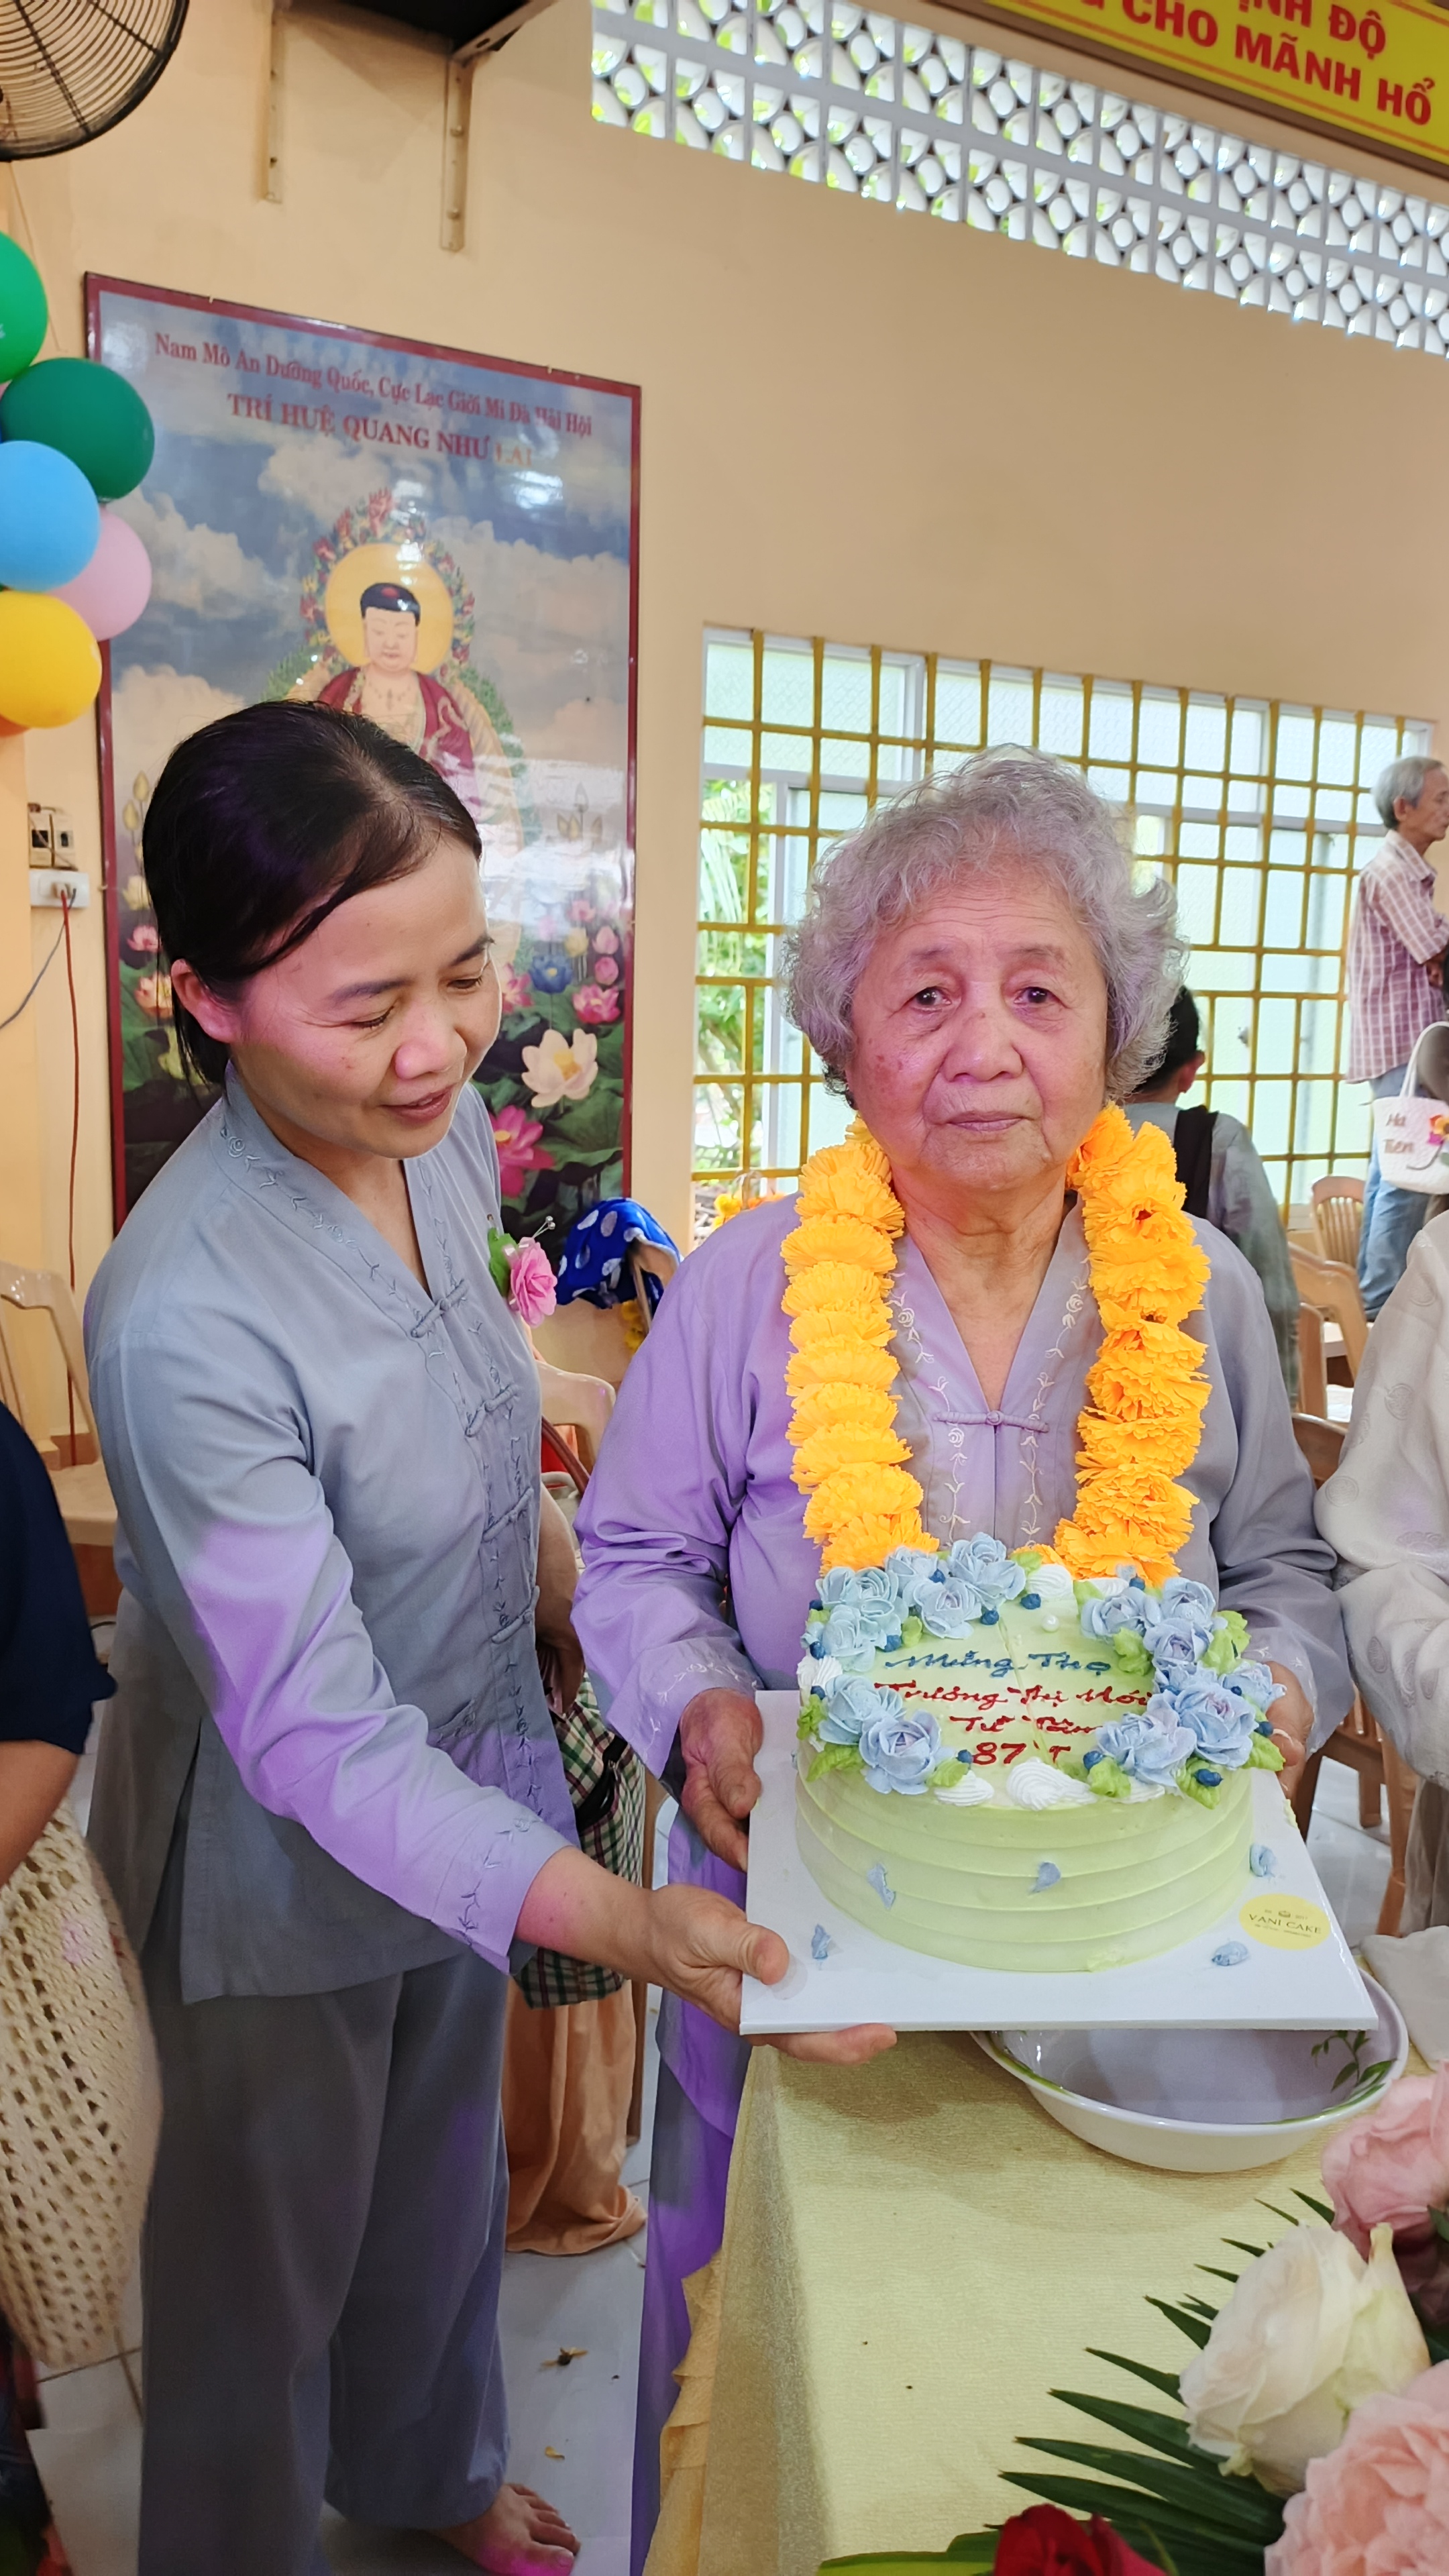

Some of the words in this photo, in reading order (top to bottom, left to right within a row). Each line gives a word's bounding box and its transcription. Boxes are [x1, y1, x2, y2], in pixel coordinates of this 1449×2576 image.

[1328, 4, 1386, 60] ĐỘ
[1235, 24, 1361, 102] MÃNH
[1377, 77, 1436, 125] HỔ
[155, 333, 197, 361] Nam
[203, 341, 231, 367] Mô
[235, 349, 260, 373] An
[415, 383, 443, 411] Lạc
[227, 392, 272, 422] TRÍ
[281, 402, 335, 436] HUỆ
[343, 415, 430, 449] QUANG
[437, 429, 491, 461] NHƯ
[1028, 1652, 1112, 1676] Thọ
[972, 1741, 1027, 1766] 87
[1249, 1913, 1281, 1926] VANI
[1286, 1921, 1322, 1934] CAKE
